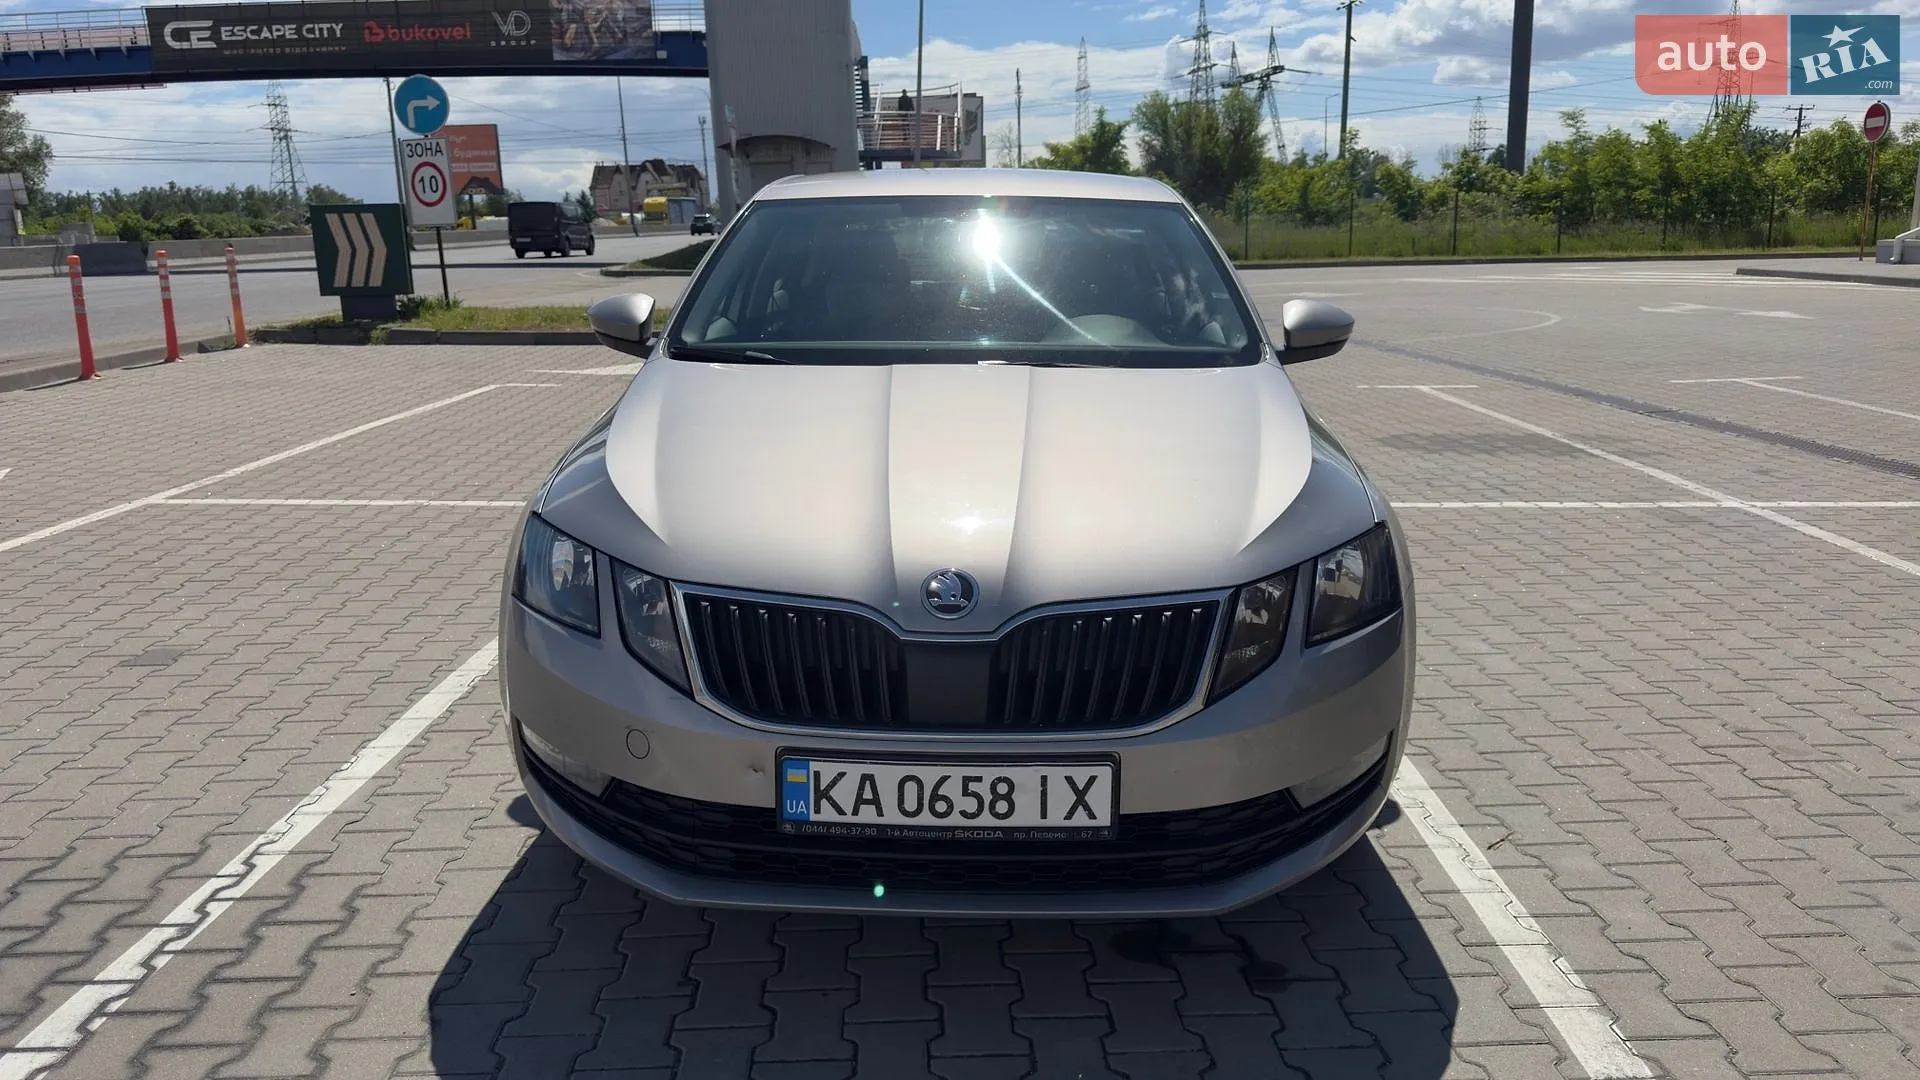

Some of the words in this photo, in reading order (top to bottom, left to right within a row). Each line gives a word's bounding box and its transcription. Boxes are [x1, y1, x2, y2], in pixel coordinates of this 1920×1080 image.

[220, 24, 298, 41] ESCAPE
[302, 23, 345, 39] CITY
[387, 22, 472, 42] bukovel
[406, 142, 444, 158] ЗОНА
[418, 175, 439, 194] 10
[813, 769, 885, 818] KA
[897, 774, 1016, 821] 0658
[1040, 774, 1099, 821] IX
[786, 799, 808, 815] UA
